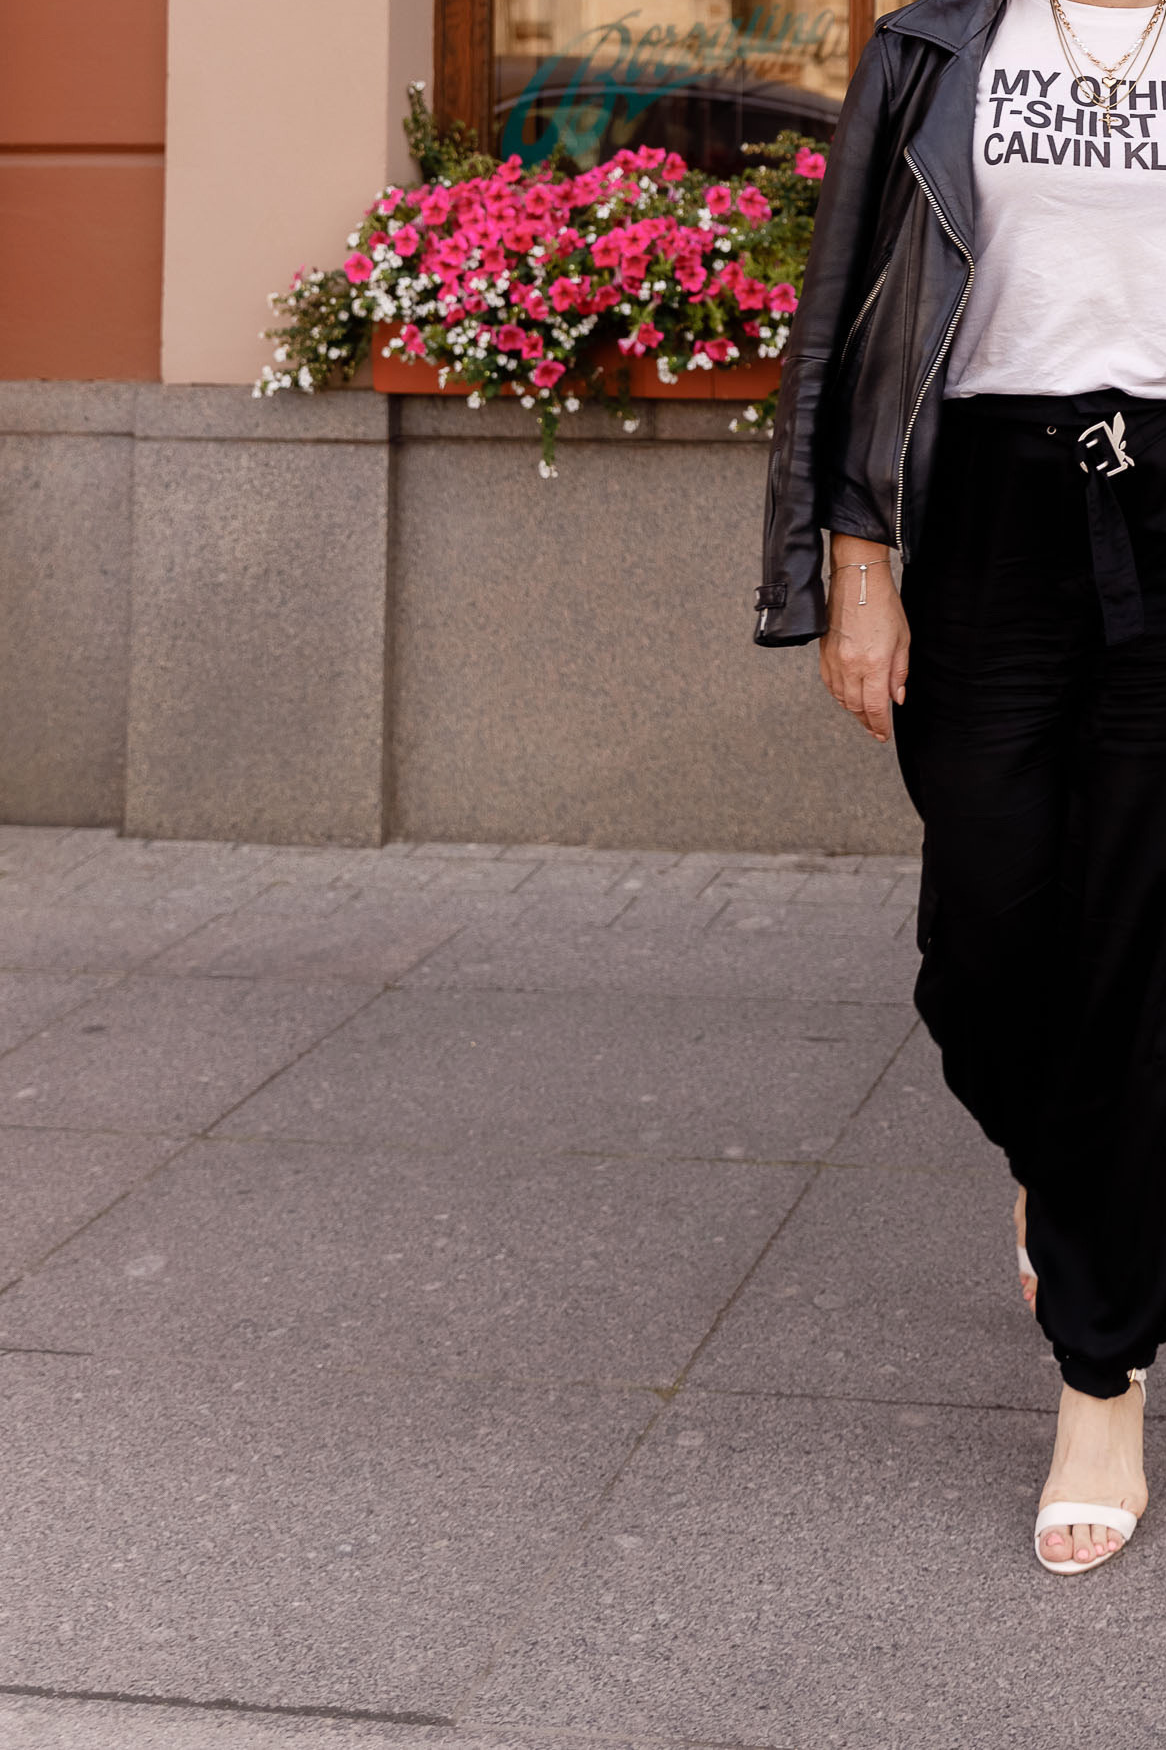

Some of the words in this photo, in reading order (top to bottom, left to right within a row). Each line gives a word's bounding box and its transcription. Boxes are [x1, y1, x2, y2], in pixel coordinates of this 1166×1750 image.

[990, 68, 1062, 98] MY
[988, 97, 1157, 139] T-SHIRT
[983, 131, 1111, 169] CALVIN
